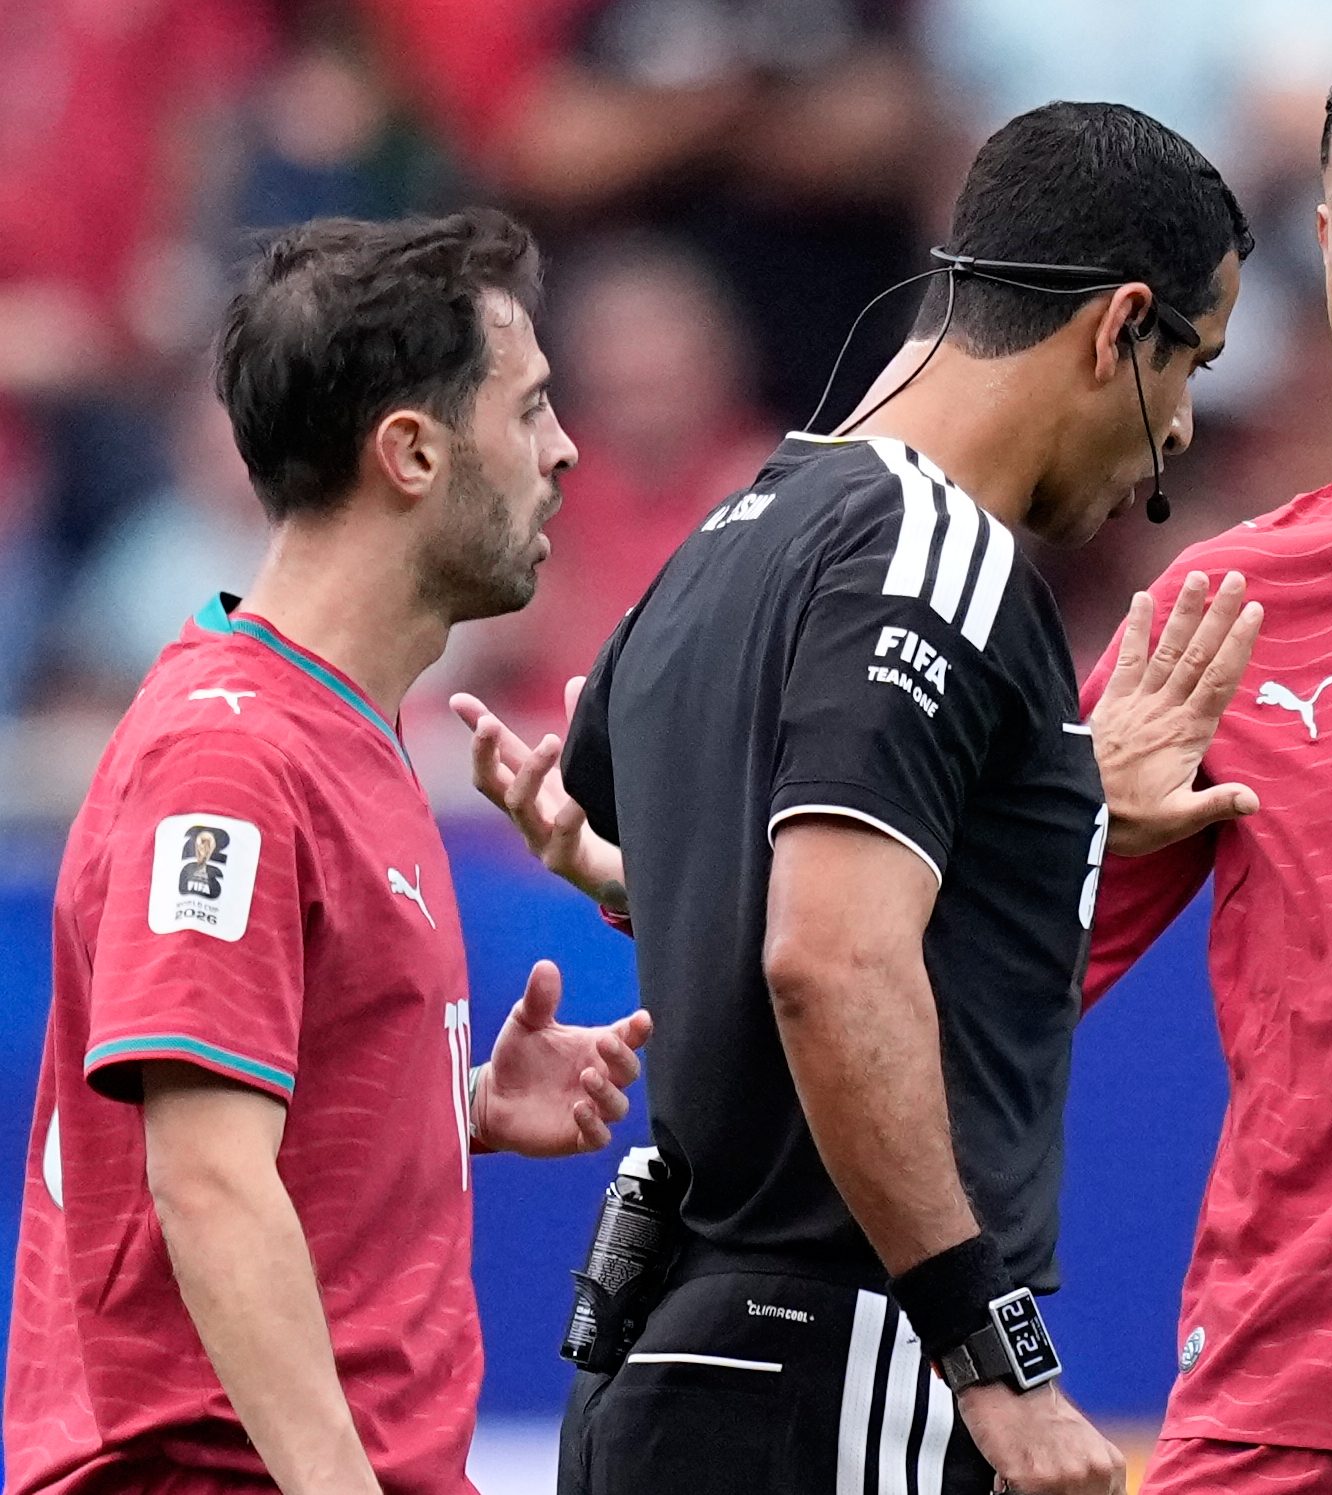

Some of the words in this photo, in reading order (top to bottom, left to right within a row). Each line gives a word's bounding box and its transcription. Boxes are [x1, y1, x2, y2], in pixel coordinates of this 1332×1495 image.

[874, 626, 945, 695] FIFA
[867, 665, 914, 694] TEAM
[912, 686, 939, 718] ONE
[186, 879, 211, 896] FIFA
[174, 908, 217, 926] 2026
[747, 1301, 808, 1323] CLIMACOOL
